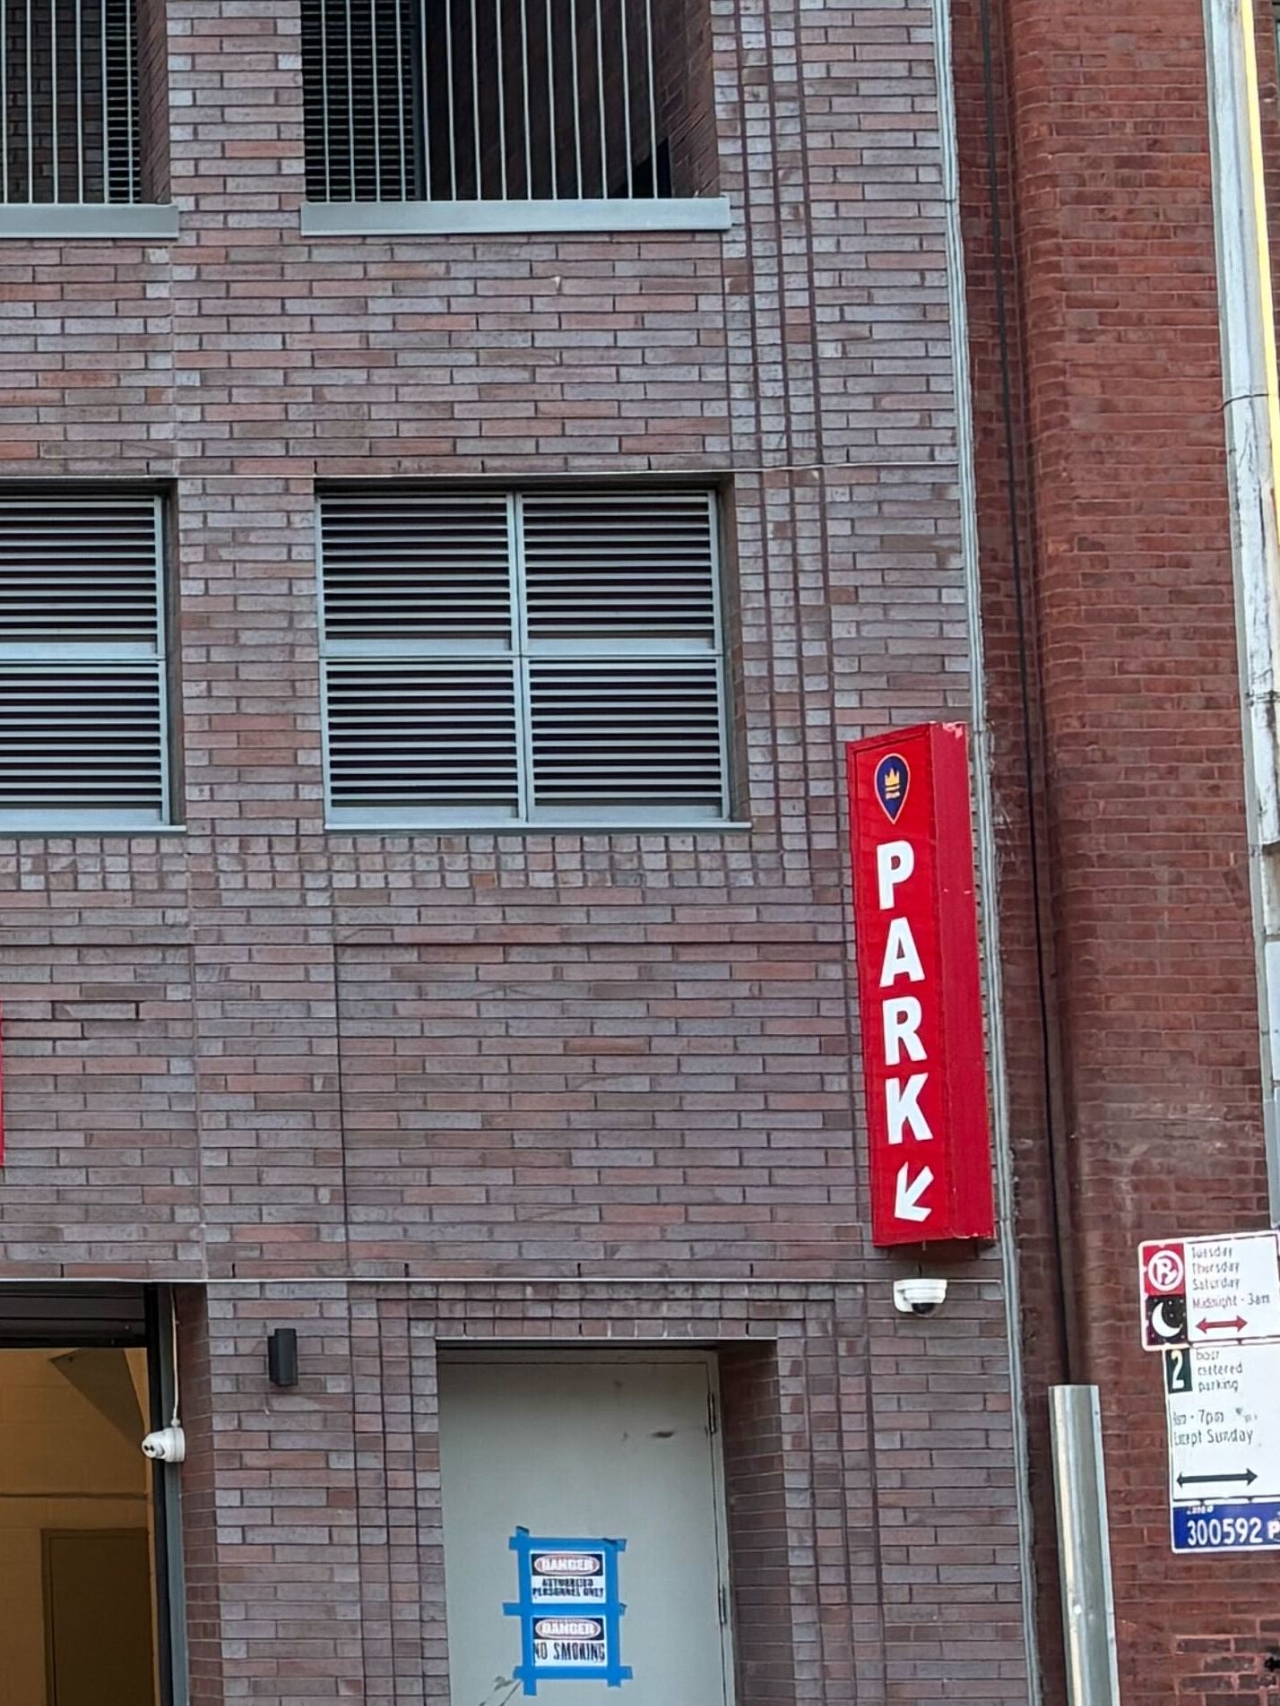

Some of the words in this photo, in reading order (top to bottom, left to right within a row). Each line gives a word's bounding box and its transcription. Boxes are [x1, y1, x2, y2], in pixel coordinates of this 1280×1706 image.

[875, 839, 934, 1145] PARK
[1171, 1349, 1185, 1389] 2
[1207, 1428, 1254, 1445] Sunday
[1187, 1517, 1263, 1546] 300592
[541, 1558, 594, 1571] DANGER
[542, 1622, 596, 1635] DANGER
[553, 1642, 605, 1662] SMOKING
